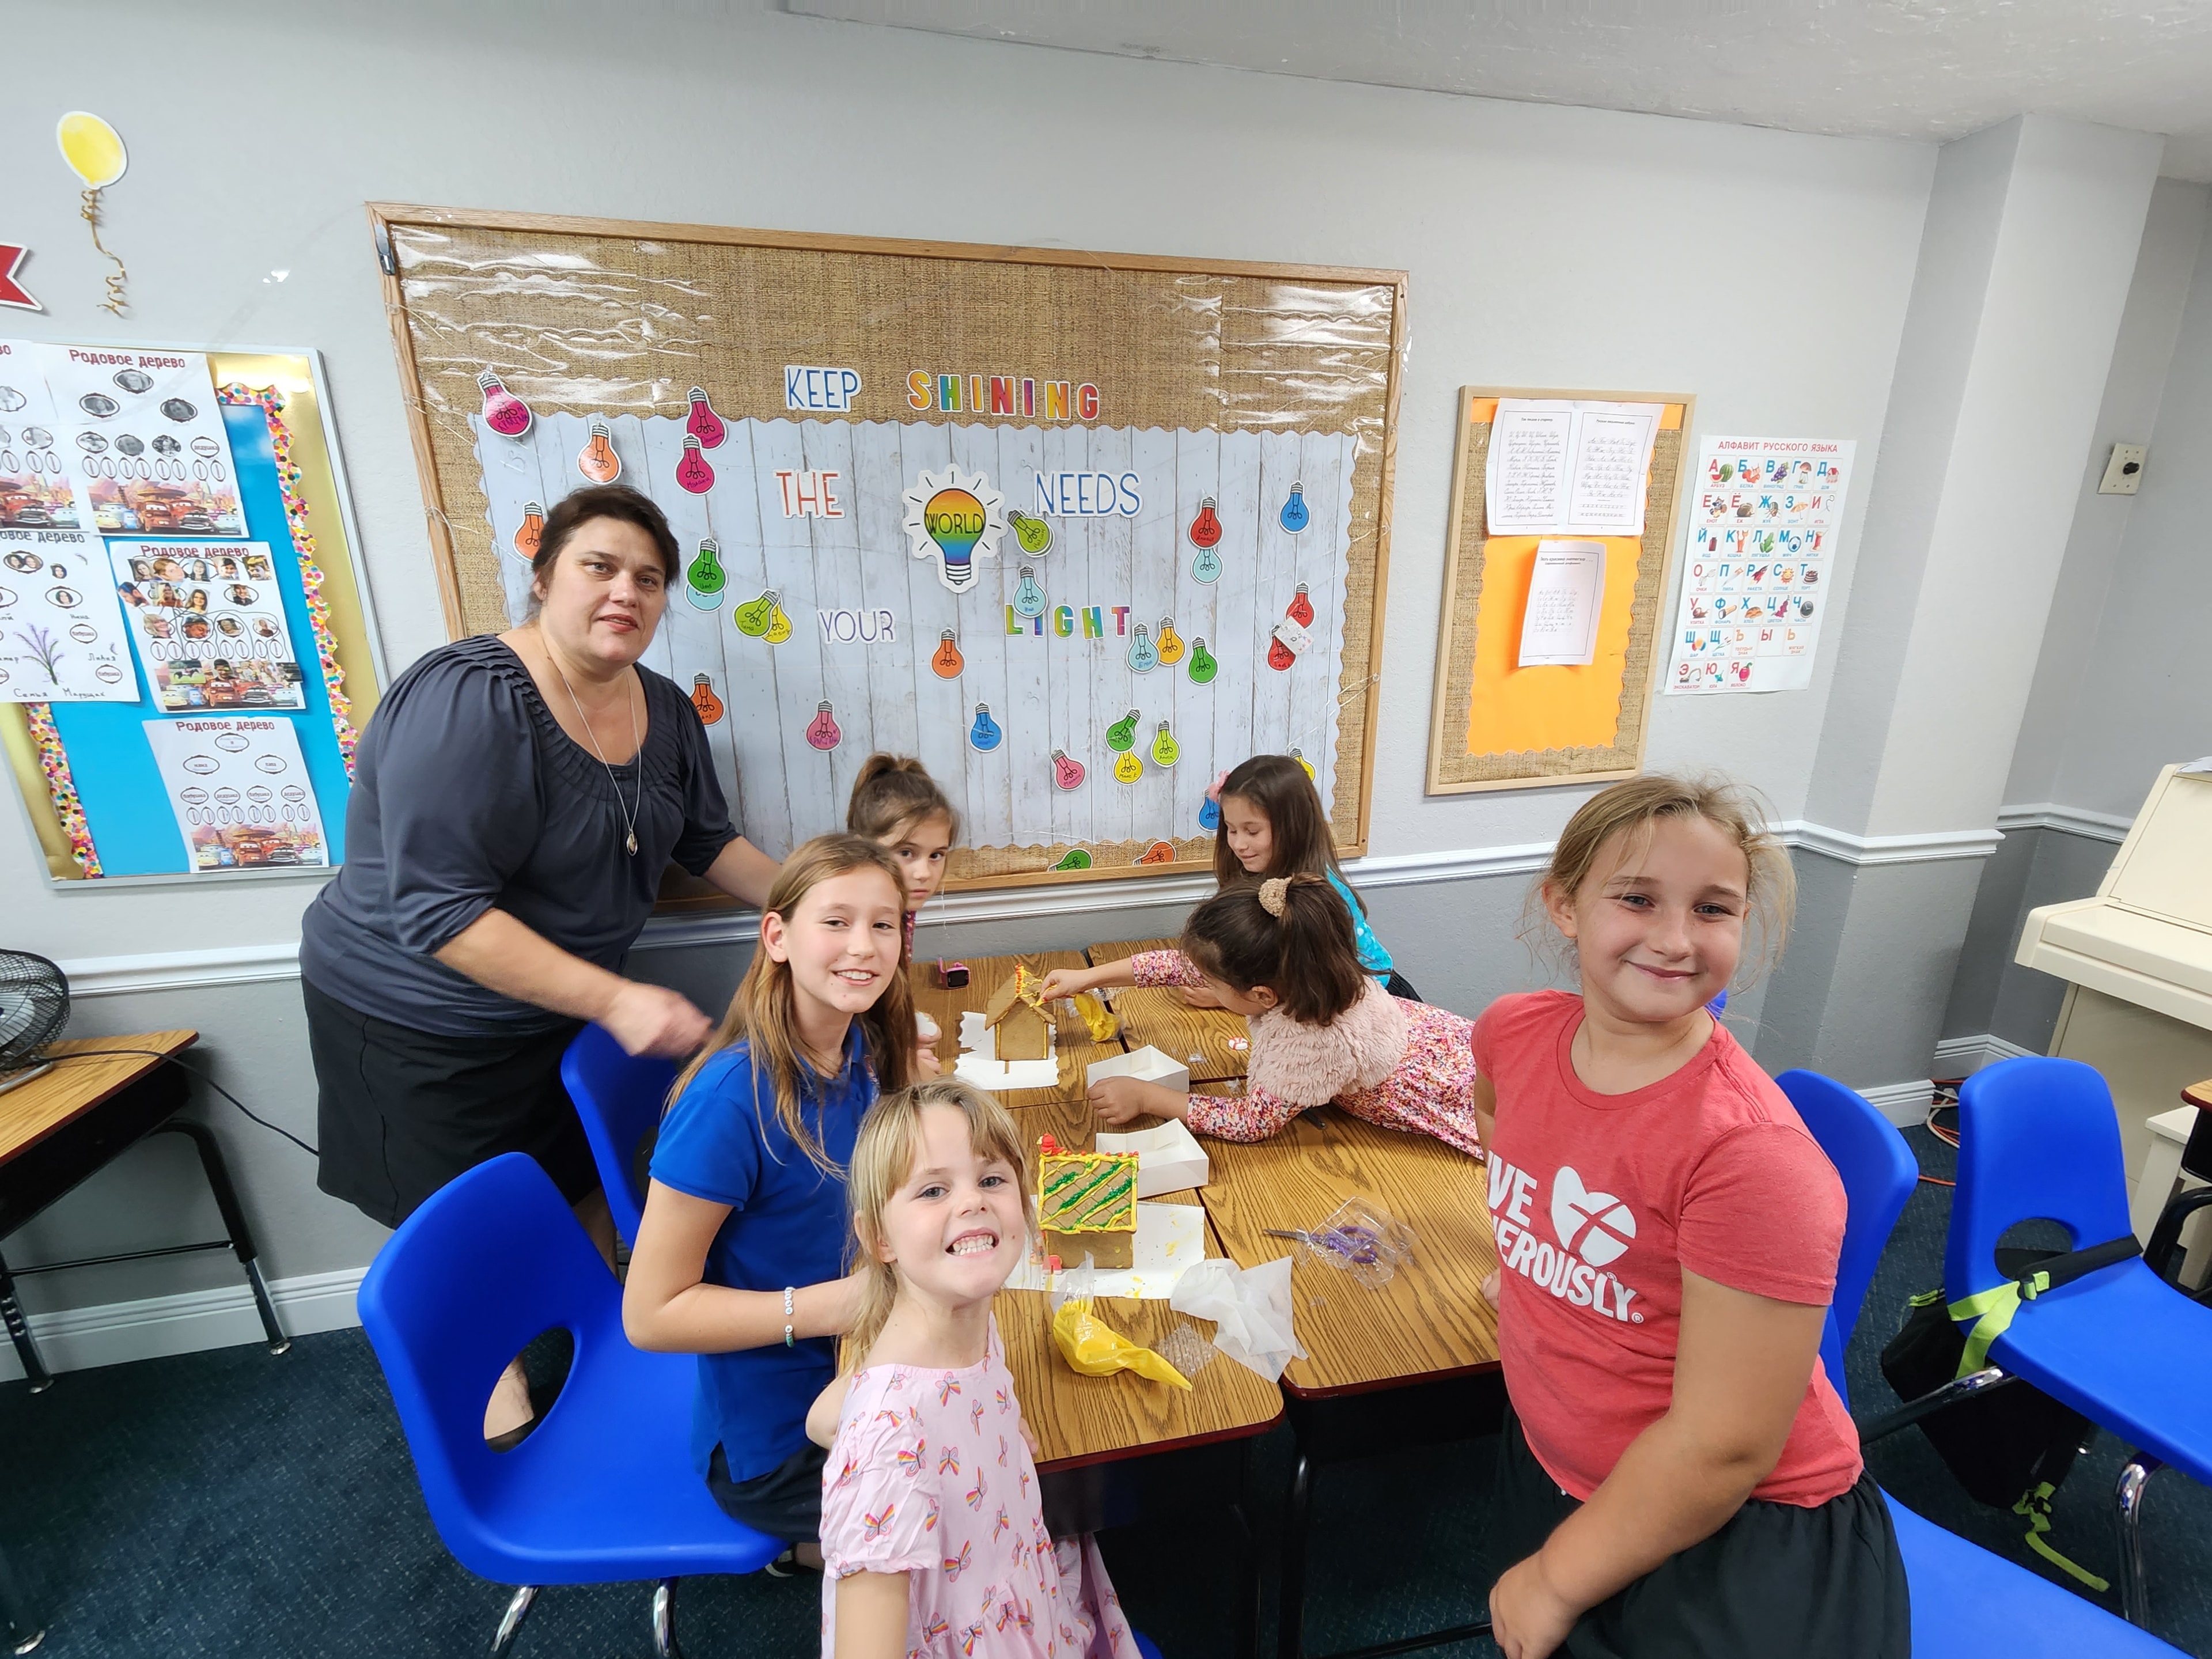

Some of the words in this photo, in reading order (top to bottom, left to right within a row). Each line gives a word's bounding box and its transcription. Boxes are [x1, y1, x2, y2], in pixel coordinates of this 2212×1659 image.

[69, 349, 133, 365] Родовое
[139, 356, 185, 369] дерево
[787, 369, 857, 410] KEEP
[908, 371, 1099, 419] SHINING
[1718, 441, 1760, 450] АЛФАВИТ
[1763, 442, 1808, 452] РУССКОГО
[1810, 444, 1838, 452] ЯЗЫКА
[1709, 459, 1718, 472] А
[1738, 460, 1748, 472] Б
[1766, 460, 1775, 472] В
[1792, 461, 1801, 474] Г
[1817, 462, 1827, 476] Д
[776, 471, 843, 516] THE
[1037, 472, 1141, 515] NEEDS
[1703, 495, 1712, 507] Е
[1731, 493, 1741, 507] Ё
[1759, 495, 1772, 508] Ж
[1786, 496, 1793, 509] З
[1812, 497, 1821, 509] И
[925, 512, 985, 535] WORLD
[0, 531, 32, 540] овое
[37, 531, 85, 543] дерево
[1698, 528, 1707, 543] Й
[1726, 530, 1736, 543] К
[1753, 530, 1762, 543] Л
[1779, 531, 1790, 543] М
[1805, 531, 1815, 542] Н
[140, 545, 200, 558] Родовое
[1694, 565, 1702, 576] О
[1720, 565, 1729, 576] П
[1747, 565, 1755, 576] Р
[1774, 564, 1782, 575] С
[1800, 564, 1808, 575] Т
[1690, 598, 1699, 610] У
[1715, 598, 1725, 609] Ф
[1741, 597, 1751, 609] Х
[1767, 597, 1777, 610] Ц
[1793, 597, 1801, 608] Ч
[822, 611, 893, 641] YOUR
[1006, 605, 1130, 639] LIGHT
[1685, 631, 1695, 643] Ш
[1710, 630, 1721, 643] Щ
[1736, 630, 1744, 641] Ъ
[1761, 630, 1772, 641] Ы
[1787, 629, 1796, 640] Ь
[1679, 664, 1689, 675] Э
[1706, 663, 1717, 675] Ю
[1730, 662, 1740, 673] Я
[176, 721, 232, 732] Родовое
[236, 721, 275, 732] дерево
[1487, 1150, 1537, 1228] VE
[1493, 1215, 1638, 1322] EROUSLY
